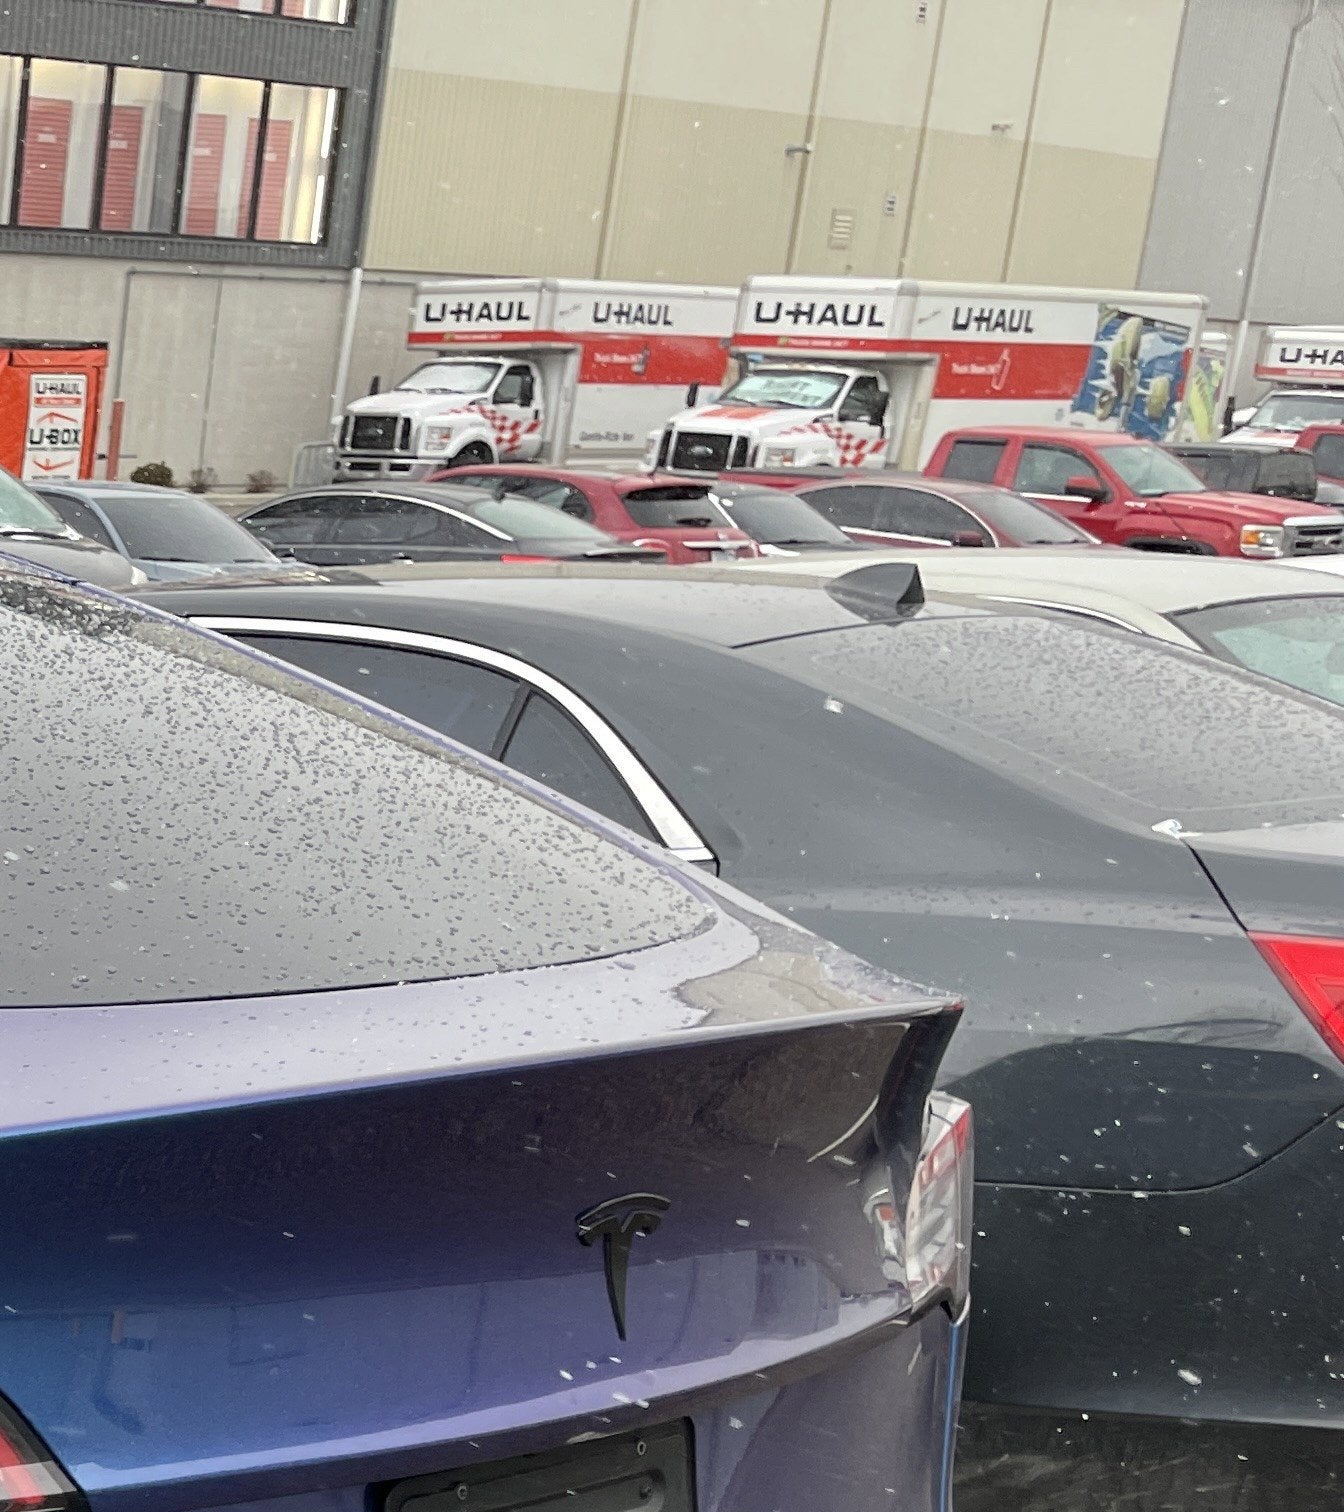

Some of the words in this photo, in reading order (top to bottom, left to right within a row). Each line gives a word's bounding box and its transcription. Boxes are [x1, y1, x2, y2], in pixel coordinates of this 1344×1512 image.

[424, 300, 532, 323] U-HAUL
[592, 301, 675, 327] U-HAUL
[753, 301, 885, 328] U-HAUL
[951, 305, 1035, 334] U-HAUL
[28, 427, 81, 446] U-BOX
